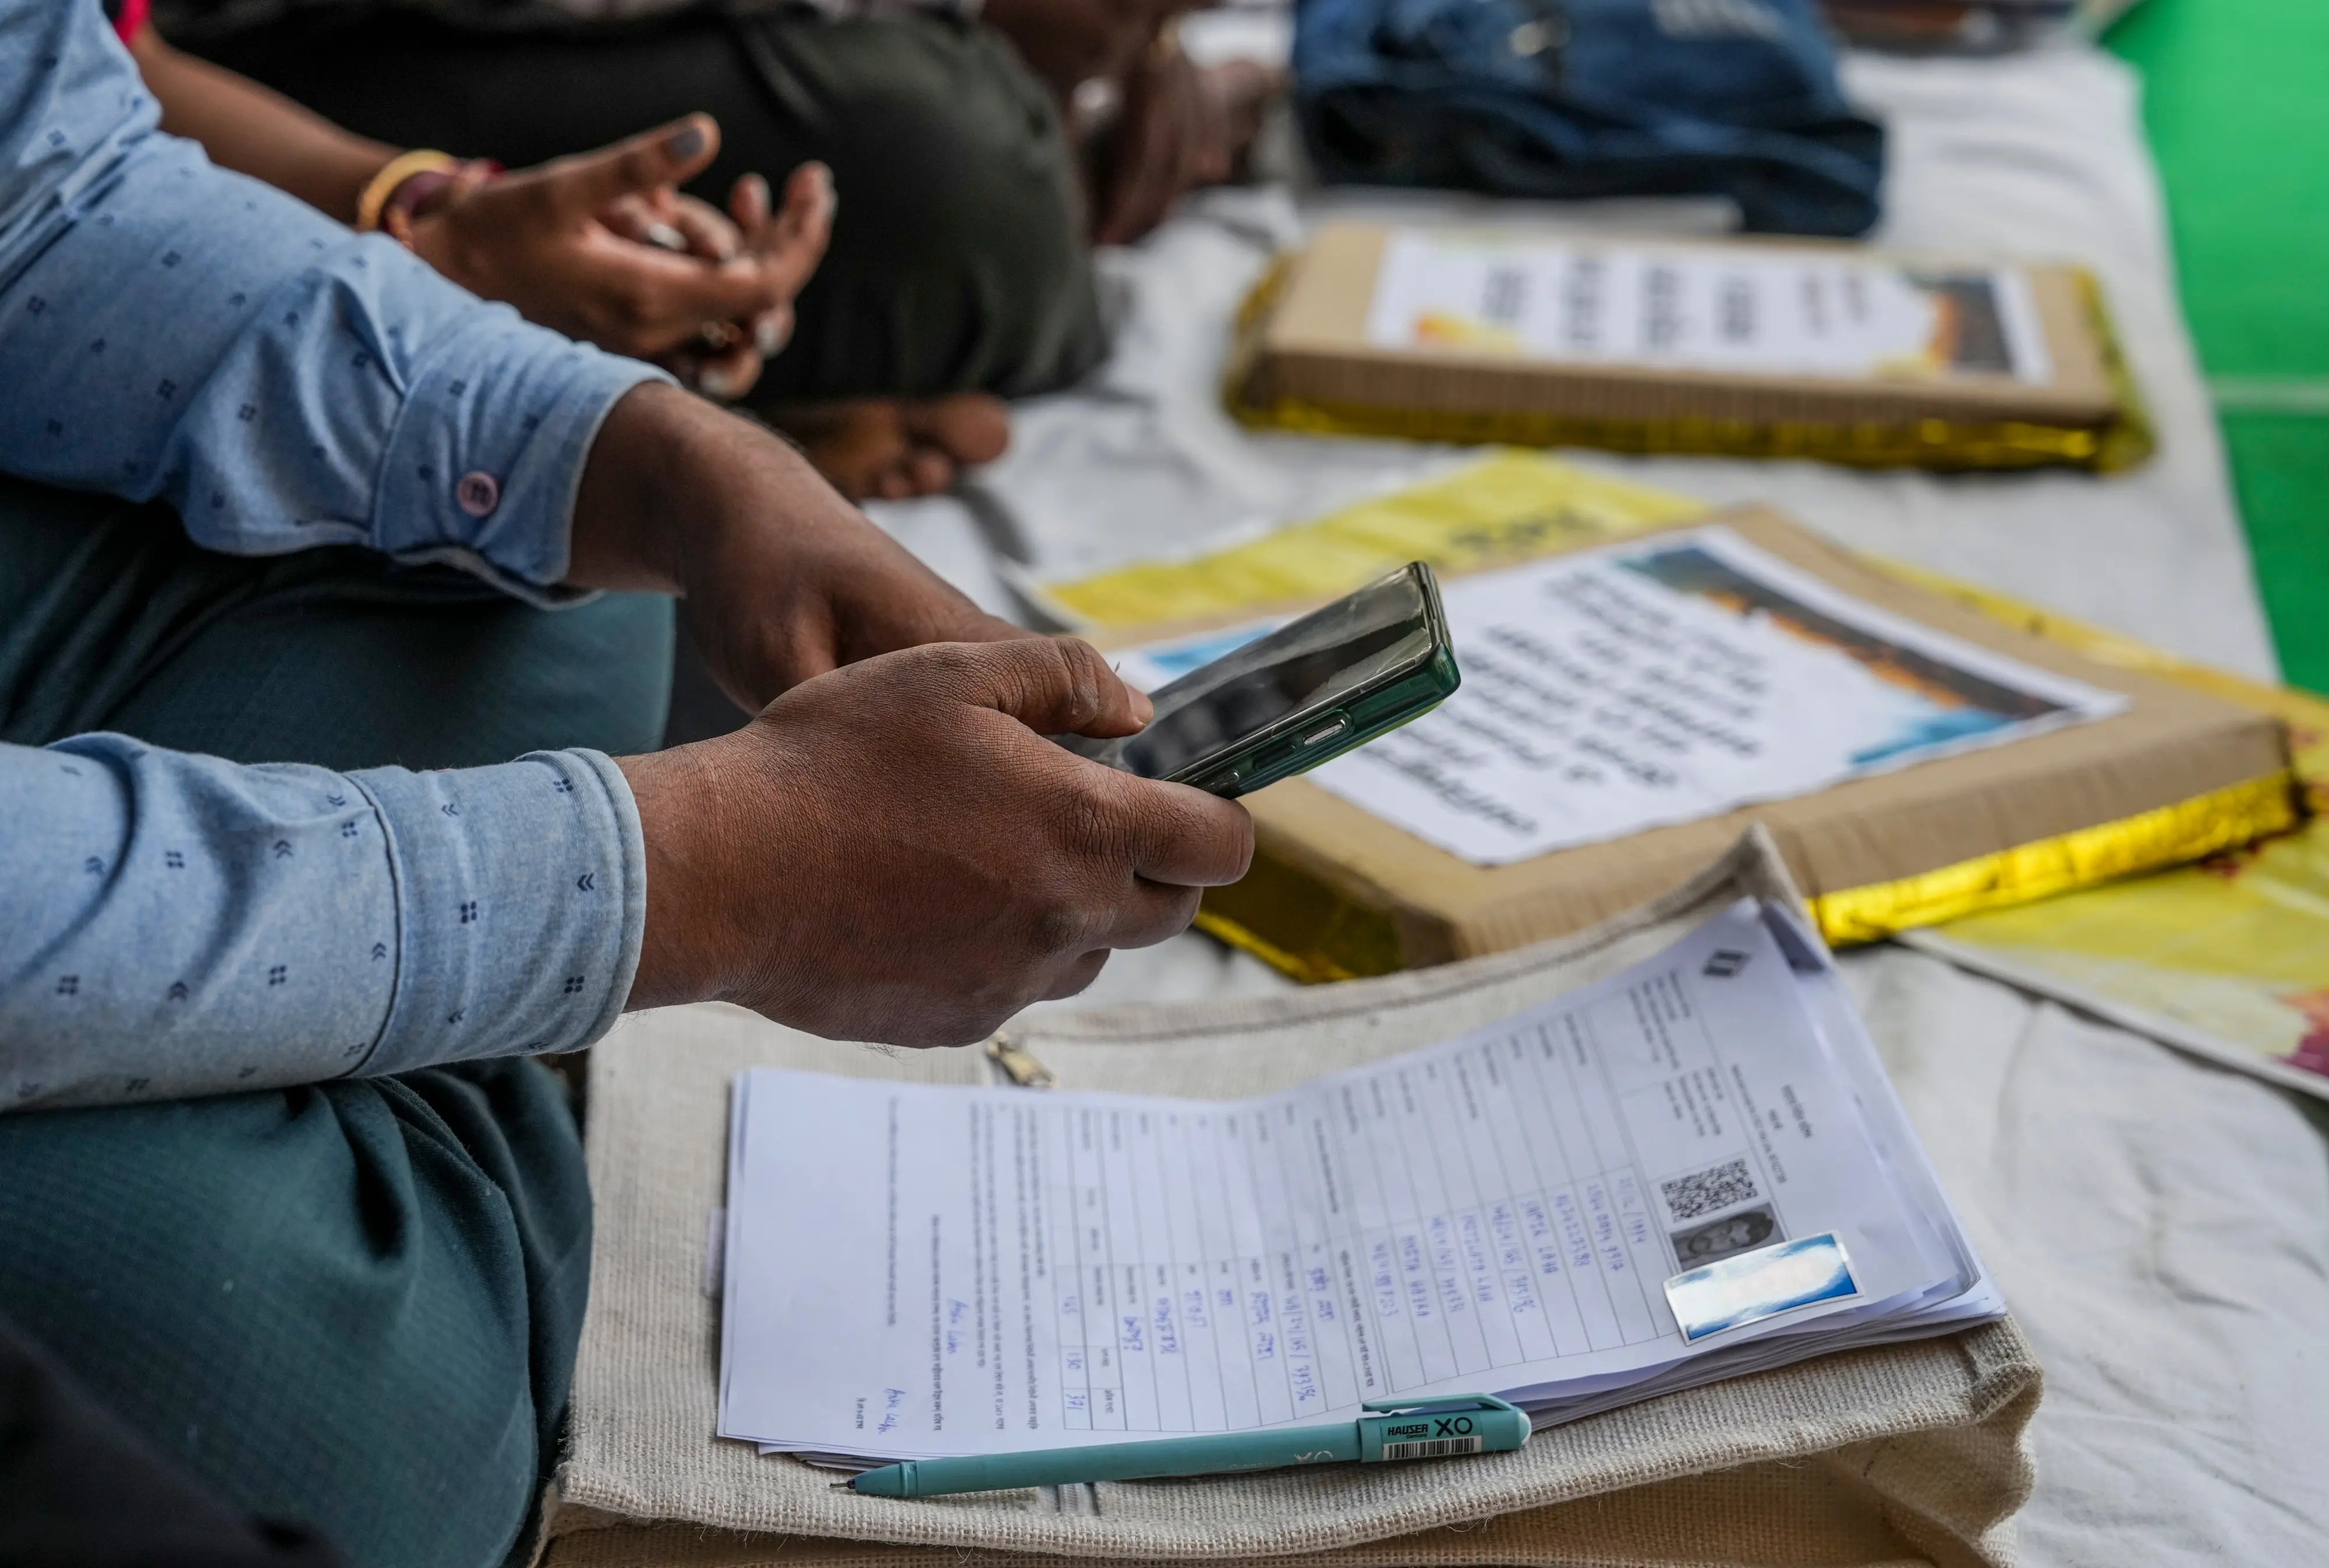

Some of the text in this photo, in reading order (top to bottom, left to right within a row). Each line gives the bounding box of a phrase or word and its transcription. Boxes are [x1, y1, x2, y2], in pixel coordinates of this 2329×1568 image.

[1067, 1352, 1082, 1369] 130
[1065, 1393, 1086, 1410] 371
[1388, 1424, 1428, 1436] HAUSER
[1434, 1417, 1473, 1437] XO
